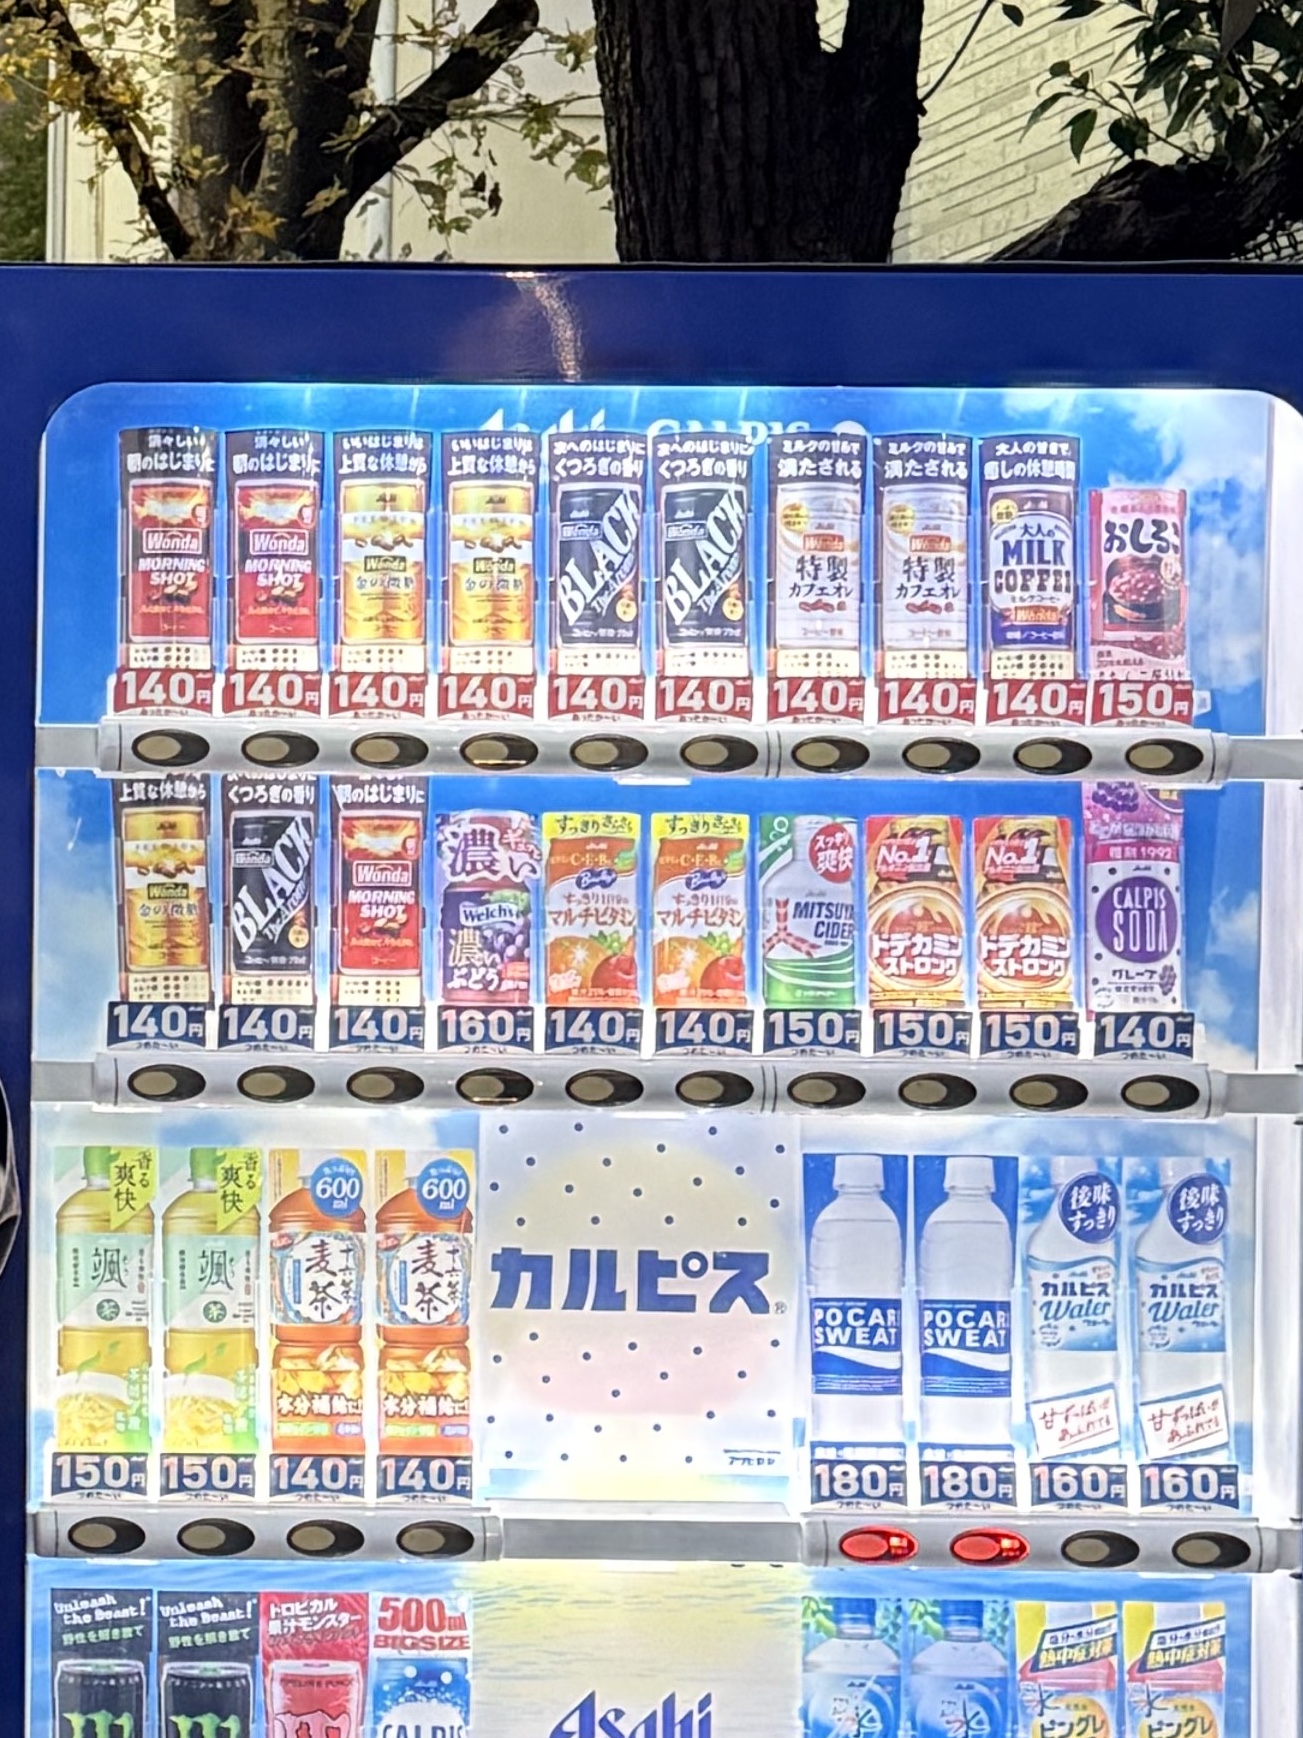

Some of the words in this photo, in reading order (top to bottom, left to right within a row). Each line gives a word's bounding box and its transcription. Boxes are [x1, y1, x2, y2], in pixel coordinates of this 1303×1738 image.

[555, 458, 644, 477] くつろぎの香り
[658, 458, 747, 479] くつろぎの香り
[777, 458, 862, 479] 満たされる
[884, 460, 968, 480] 満たされる
[147, 531, 201, 550] Wonda
[253, 532, 306, 551] Wonda
[1002, 539, 1066, 566] MILK
[138, 557, 207, 572] MORNING
[245, 558, 312, 573] MORNING
[560, 487, 641, 626] BLACK
[665, 488, 745, 626] BLACK
[796, 555, 848, 581] 特製
[902, 556, 956, 583] 特製
[150, 571, 198, 586] SHOT
[256, 573, 304, 587] SHOT
[789, 582, 854, 598] カフェオレ
[895, 583, 961, 599] カフェオレ
[122, 671, 210, 705] 140円
[230, 673, 319, 706] 140円
[334, 675, 423, 708] 140円
[443, 676, 533, 709] 140円
[553, 677, 643, 710] 140円
[659, 679, 751, 711] 140円
[773, 680, 864, 713] 140円
[884, 682, 975, 715] 140円
[993, 683, 1085, 716] 140円
[1098, 683, 1189, 716] 150円
[228, 784, 315, 804] くつろぎの香り
[817, 847, 855, 873] 爽快
[877, 835, 933, 865] No.1
[986, 837, 1041, 867] No.1
[231, 815, 314, 953] BLACK
[358, 864, 410, 883] Wonda
[348, 890, 416, 904] MORNING
[360, 904, 408, 919] SHOT
[1112, 884, 1168, 910] CALPIS
[548, 907, 637, 928] マルチビタミン
[657, 907, 746, 928] マルチビタミン
[1112, 910, 1169, 953] SODA
[872, 932, 963, 958] ドデカミン
[981, 933, 1071, 960] ドデカミン
[447, 967, 500, 992] ぶどう
[883, 957, 957, 976] ストロング
[992, 958, 1065, 978] ストロング
[113, 1004, 204, 1038] 140円
[223, 1007, 314, 1041] 140円
[334, 1008, 424, 1041] 140円
[441, 1009, 532, 1043] 160円
[551, 1010, 641, 1043] 140円
[660, 1011, 751, 1044] 140円
[769, 1011, 860, 1045] 150円
[879, 1013, 970, 1047] 150円
[986, 1014, 1076, 1048] 150円
[1101, 1015, 1191, 1049] 140円
[315, 1177, 361, 1200] 600
[421, 1178, 467, 1201] 600
[1070, 1181, 1112, 1211] 後味
[1178, 1183, 1221, 1212] 後味
[1067, 1205, 1116, 1234] すっきり
[1176, 1206, 1225, 1235] すっきり
[304, 1239, 343, 1320] 麦茶
[410, 1239, 450, 1321] 麦茶
[490, 1247, 772, 1315] カルピス
[1040, 1281, 1111, 1297] カルピス
[1149, 1282, 1219, 1299] カルピス
[1039, 1299, 1112, 1322] Water
[1148, 1299, 1220, 1323] Water
[813, 1327, 898, 1346] SWEAT
[923, 1328, 1006, 1348] SWEAT
[55, 1455, 146, 1489] 150円
[163, 1456, 253, 1490] 150円
[274, 1457, 364, 1490] 140円
[381, 1458, 471, 1491] 140円
[814, 1463, 904, 1498] 180円
[924, 1465, 1014, 1499] 180円
[1034, 1465, 1126, 1500] 160円
[1144, 1466, 1236, 1501] 160円
[53, 1594, 117, 1615] Unleash
[159, 1596, 224, 1618] Unleash
[269, 1597, 338, 1619] トロピカル
[377, 1596, 468, 1633] 500ml
[268, 1611, 362, 1636] 果汁モンスター
